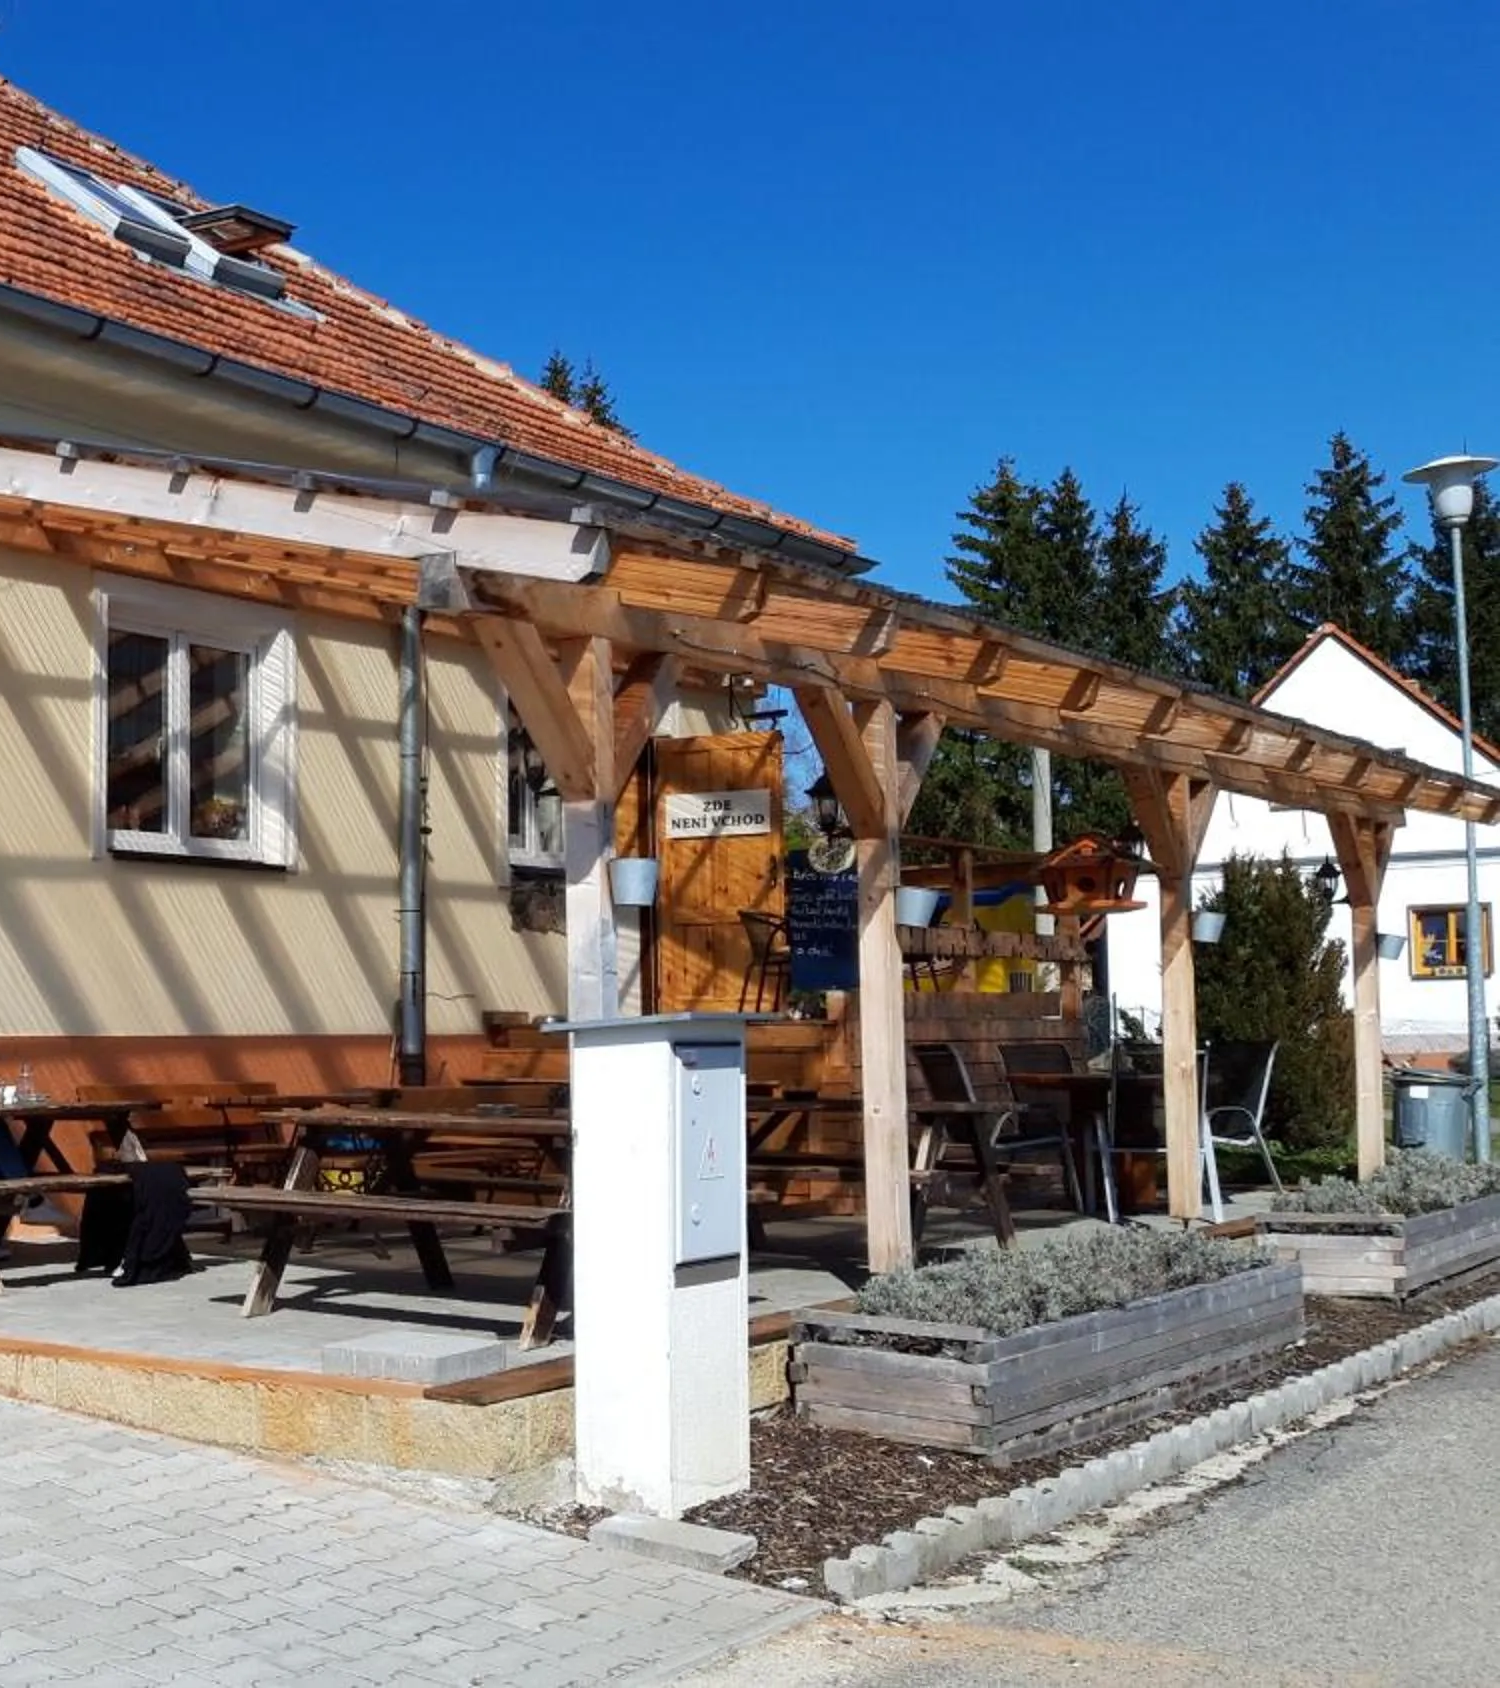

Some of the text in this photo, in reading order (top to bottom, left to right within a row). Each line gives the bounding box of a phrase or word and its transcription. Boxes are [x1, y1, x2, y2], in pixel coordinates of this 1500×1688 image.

[703, 799, 732, 812] ZDE
[671, 813, 765, 830] NENÍ VCHOD
